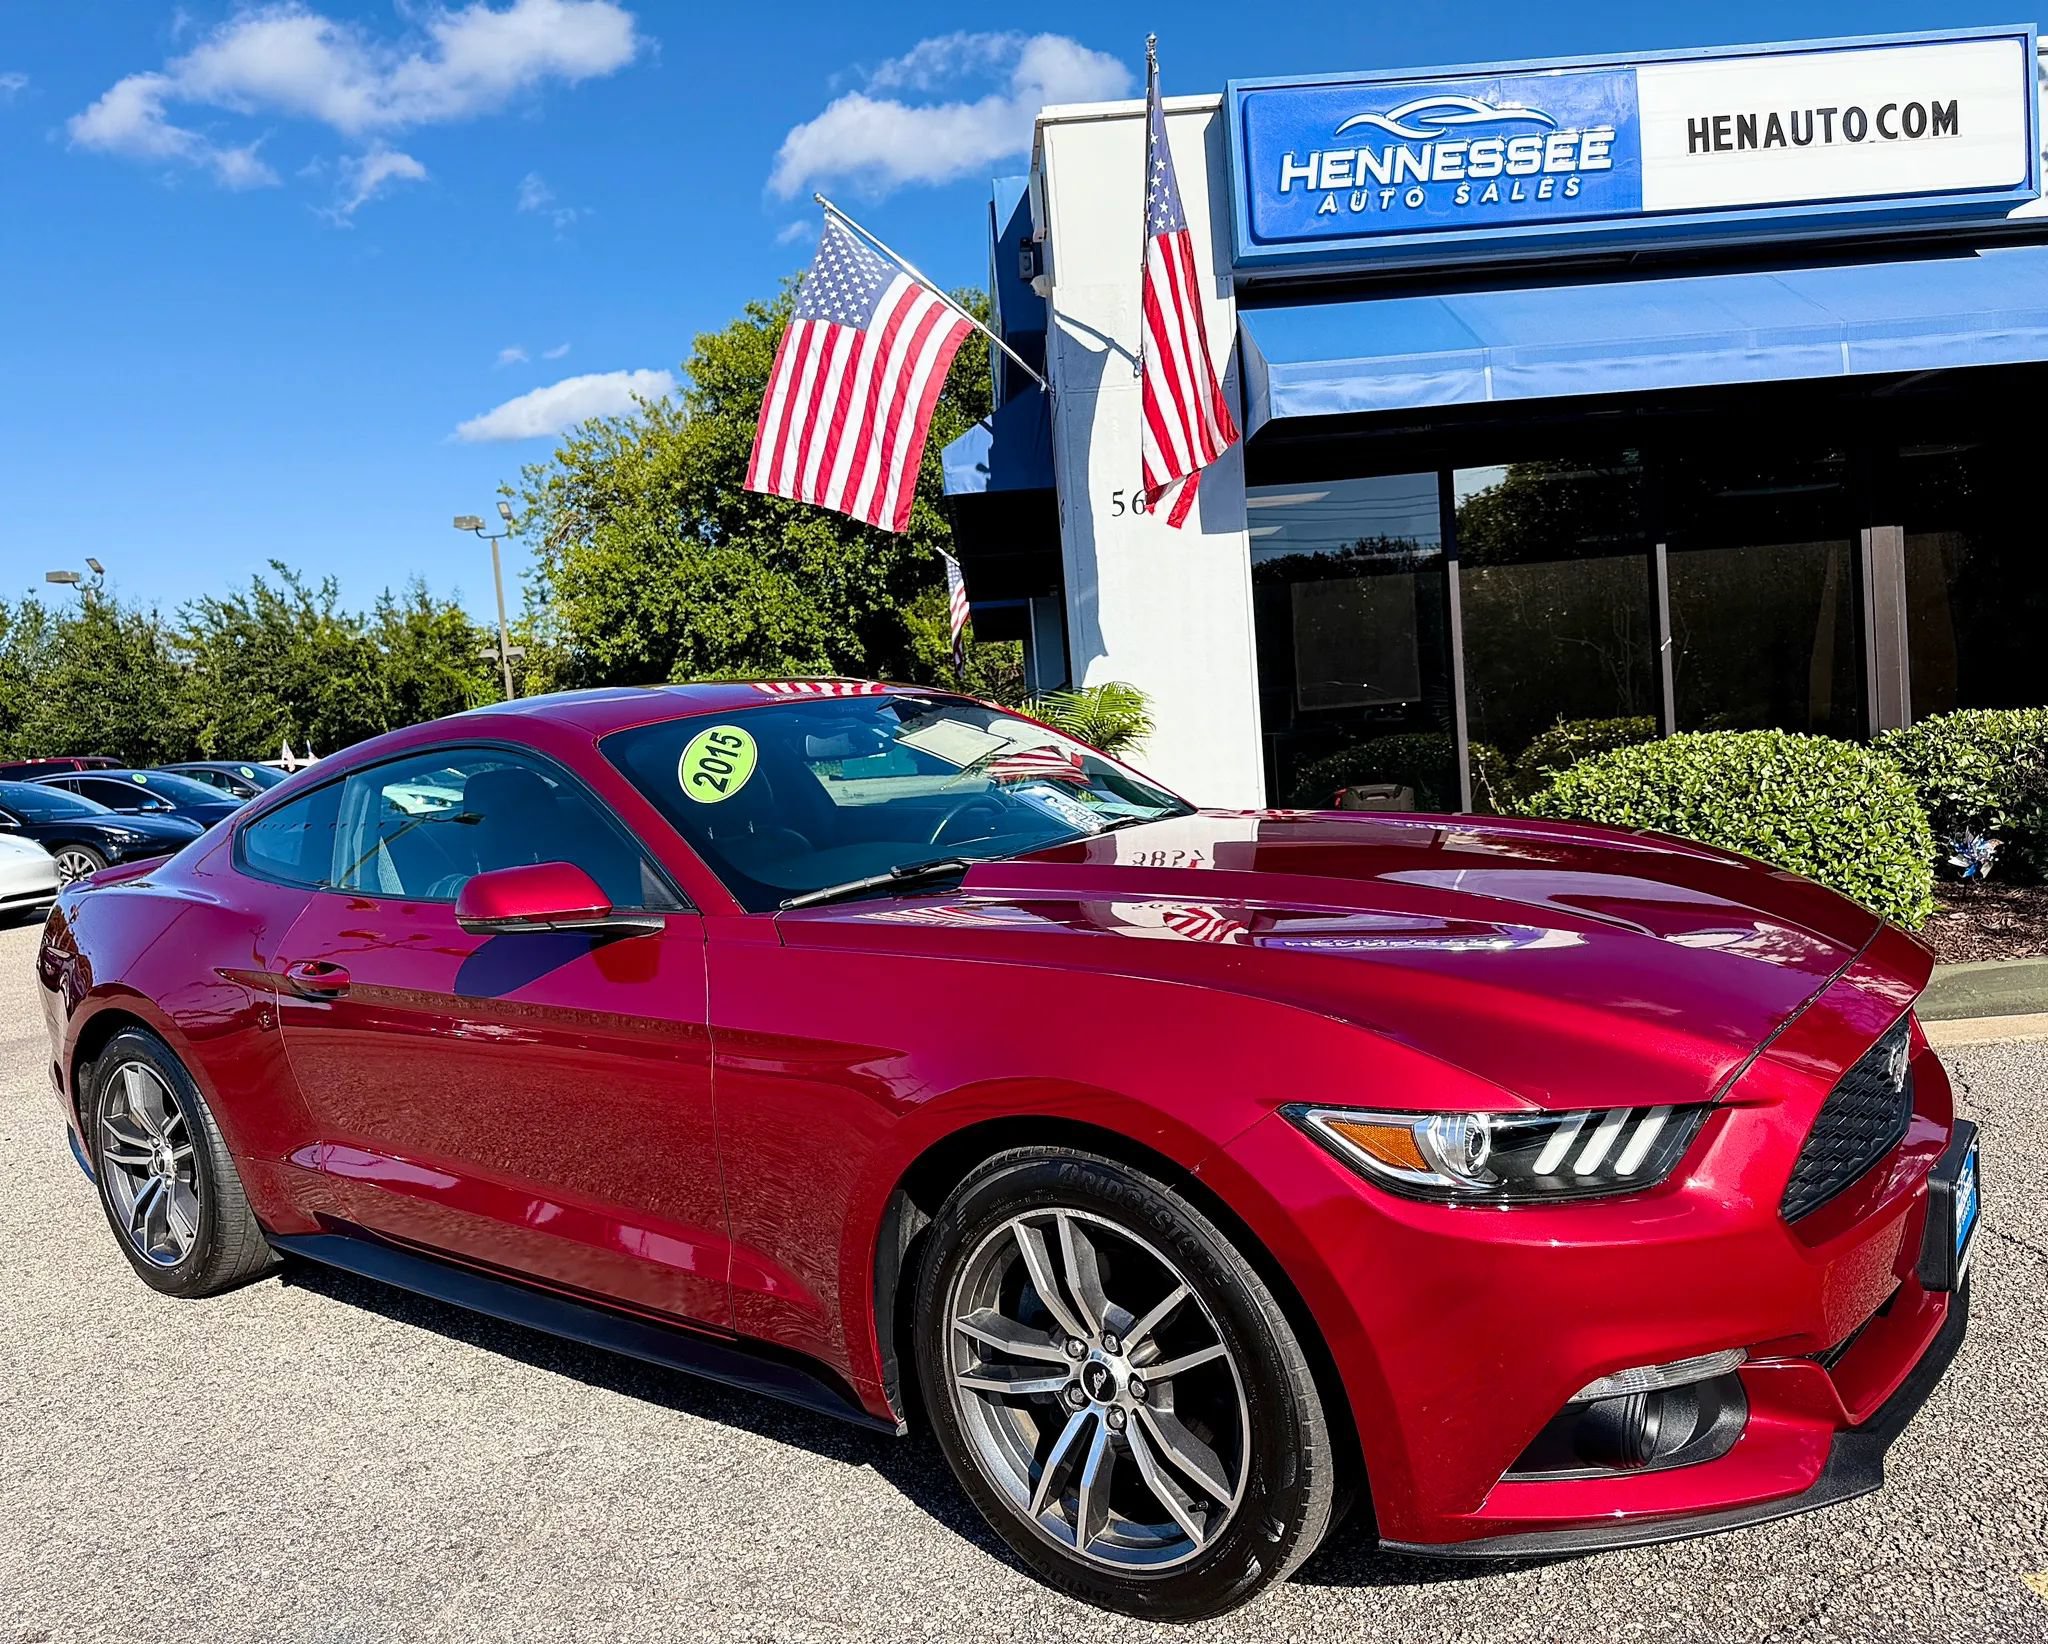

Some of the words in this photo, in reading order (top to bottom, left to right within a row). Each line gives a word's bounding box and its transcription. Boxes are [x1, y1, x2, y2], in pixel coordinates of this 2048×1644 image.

[1280, 127, 1616, 192] HENNESSEE
[1318, 187, 1424, 214] AUTO
[1454, 175, 1581, 205] SALES
[692, 731, 743, 794] 2015
